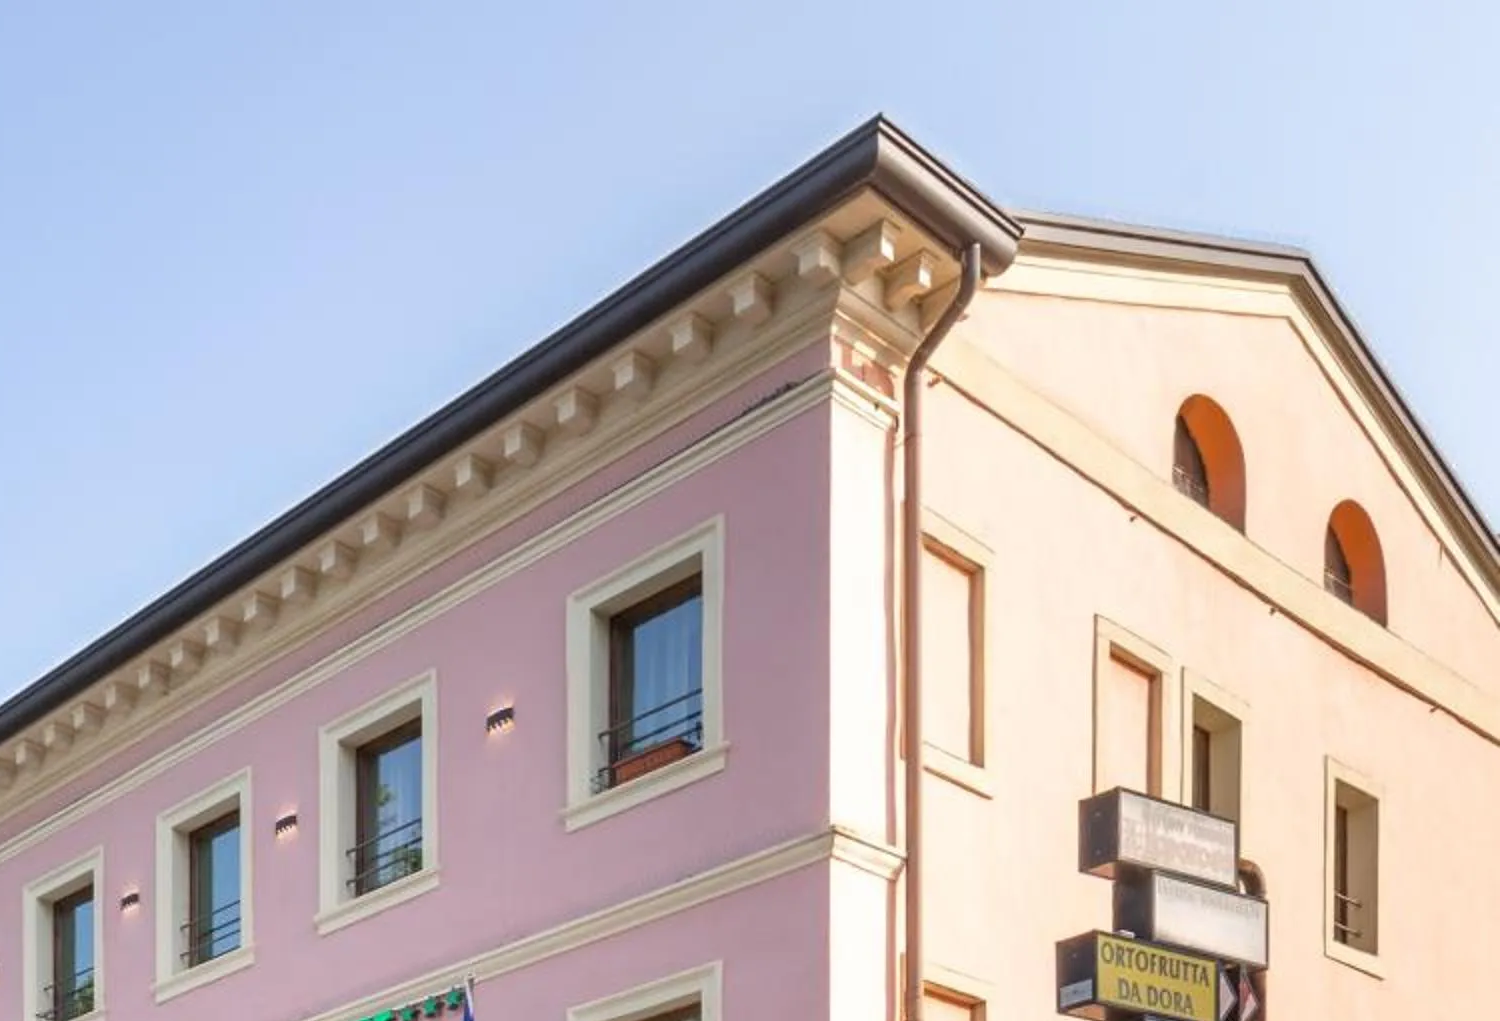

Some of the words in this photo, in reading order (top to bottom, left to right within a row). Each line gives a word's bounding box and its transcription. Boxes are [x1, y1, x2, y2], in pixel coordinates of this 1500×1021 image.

[1101, 941, 1210, 989] ORTOFRUTTA
[1117, 977, 1142, 1004] DA
[1146, 984, 1196, 1016] DORA
